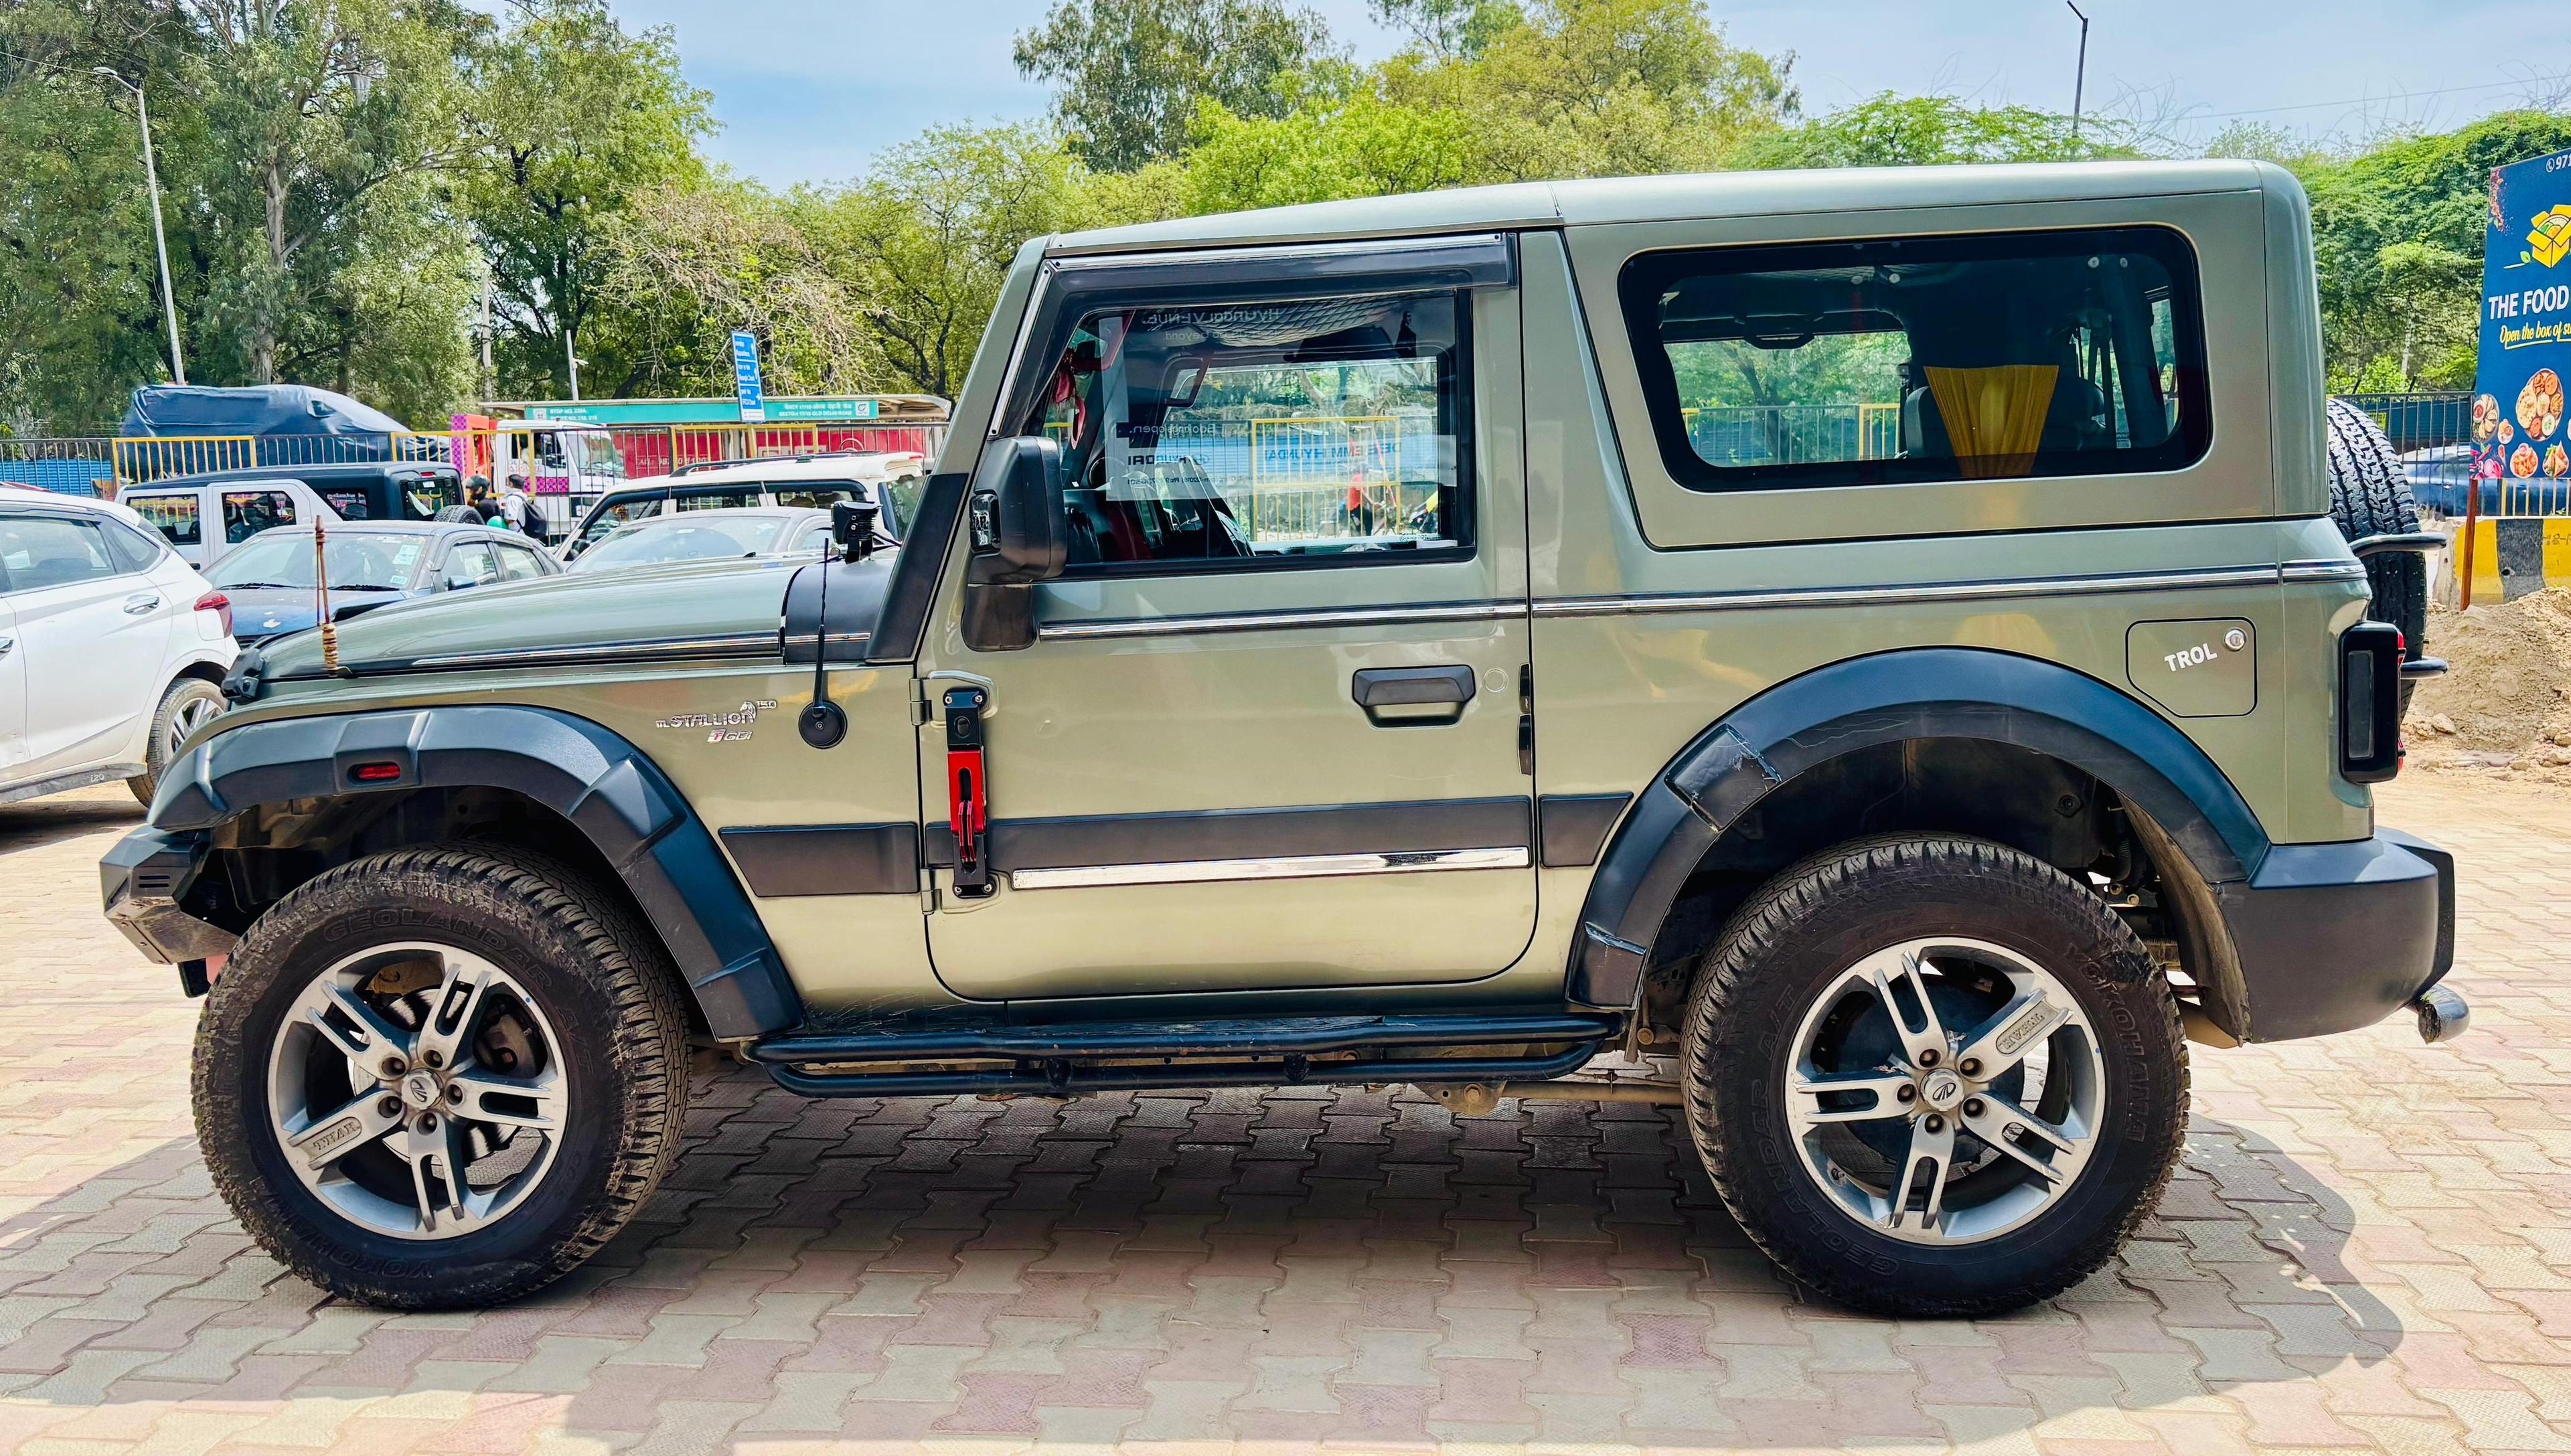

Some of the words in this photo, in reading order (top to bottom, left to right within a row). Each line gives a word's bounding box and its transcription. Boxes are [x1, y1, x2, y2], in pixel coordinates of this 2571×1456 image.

[2488, 293, 2519, 320] THE
[2522, 285, 2570, 316] FOOD
[2499, 325, 2520, 349] Open
[2521, 322, 2534, 340] the
[2536, 320, 2552, 338] box
[2552, 321, 2563, 342] of
[2164, 643, 2217, 672] TROL
[757, 700, 777, 710] 150
[323, 908, 552, 989] GEOLANDAR
[1751, 1078, 1899, 1276] GEOLANDAR
